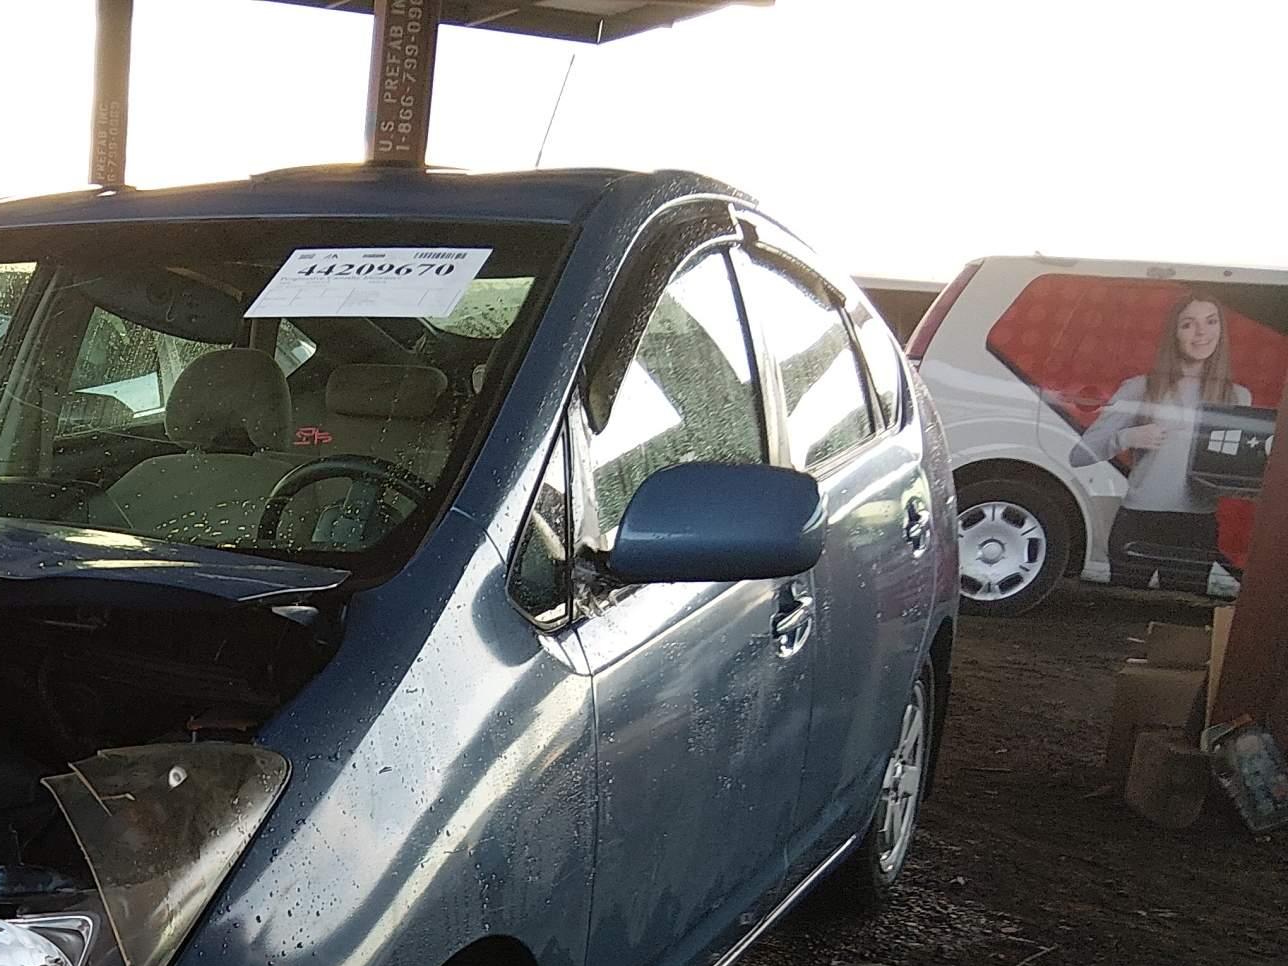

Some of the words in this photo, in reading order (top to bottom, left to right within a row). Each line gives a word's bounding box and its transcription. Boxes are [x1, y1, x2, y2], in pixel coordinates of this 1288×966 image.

[383, 25, 404, 104] PREFAB
[95, 130, 109, 180] PREFAB
[297, 262, 455, 277] 44209670
